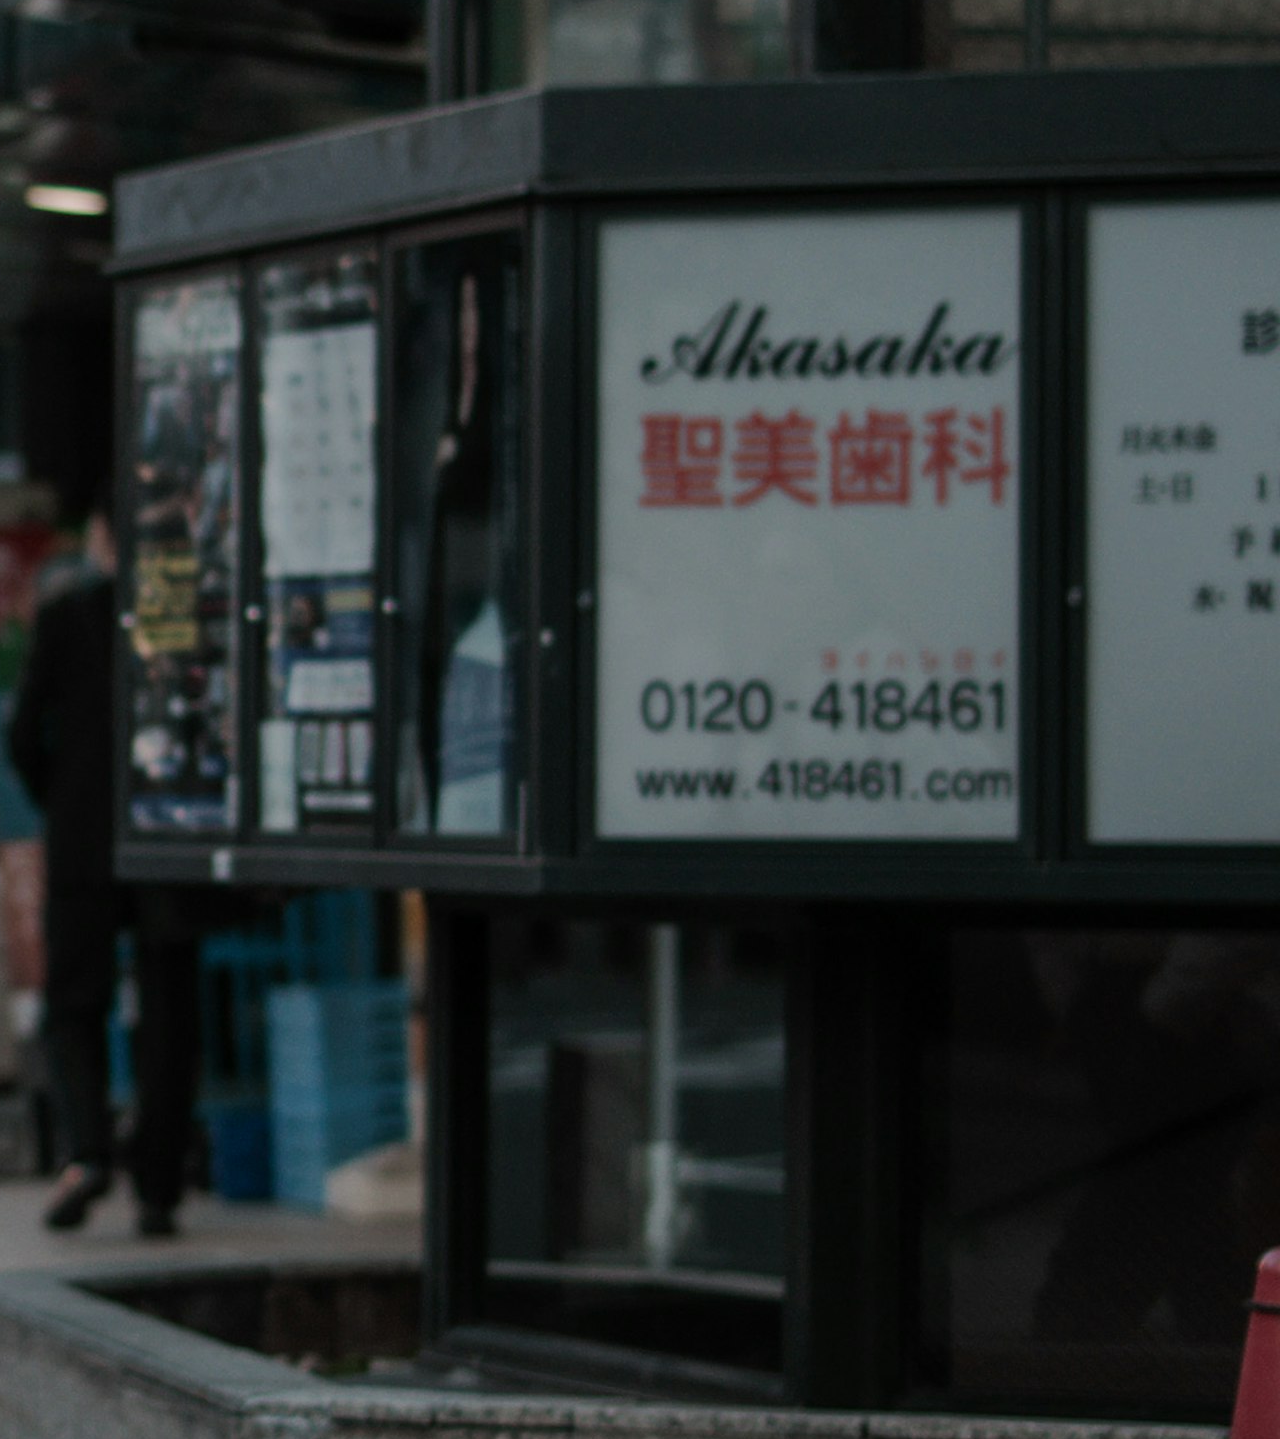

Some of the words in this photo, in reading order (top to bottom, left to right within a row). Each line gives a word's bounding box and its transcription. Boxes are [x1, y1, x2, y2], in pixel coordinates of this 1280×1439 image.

[642, 299, 1016, 383] Akasaka
[639, 407, 1010, 509] 聖美歯科
[637, 759, 1014, 803] www.418461.com
